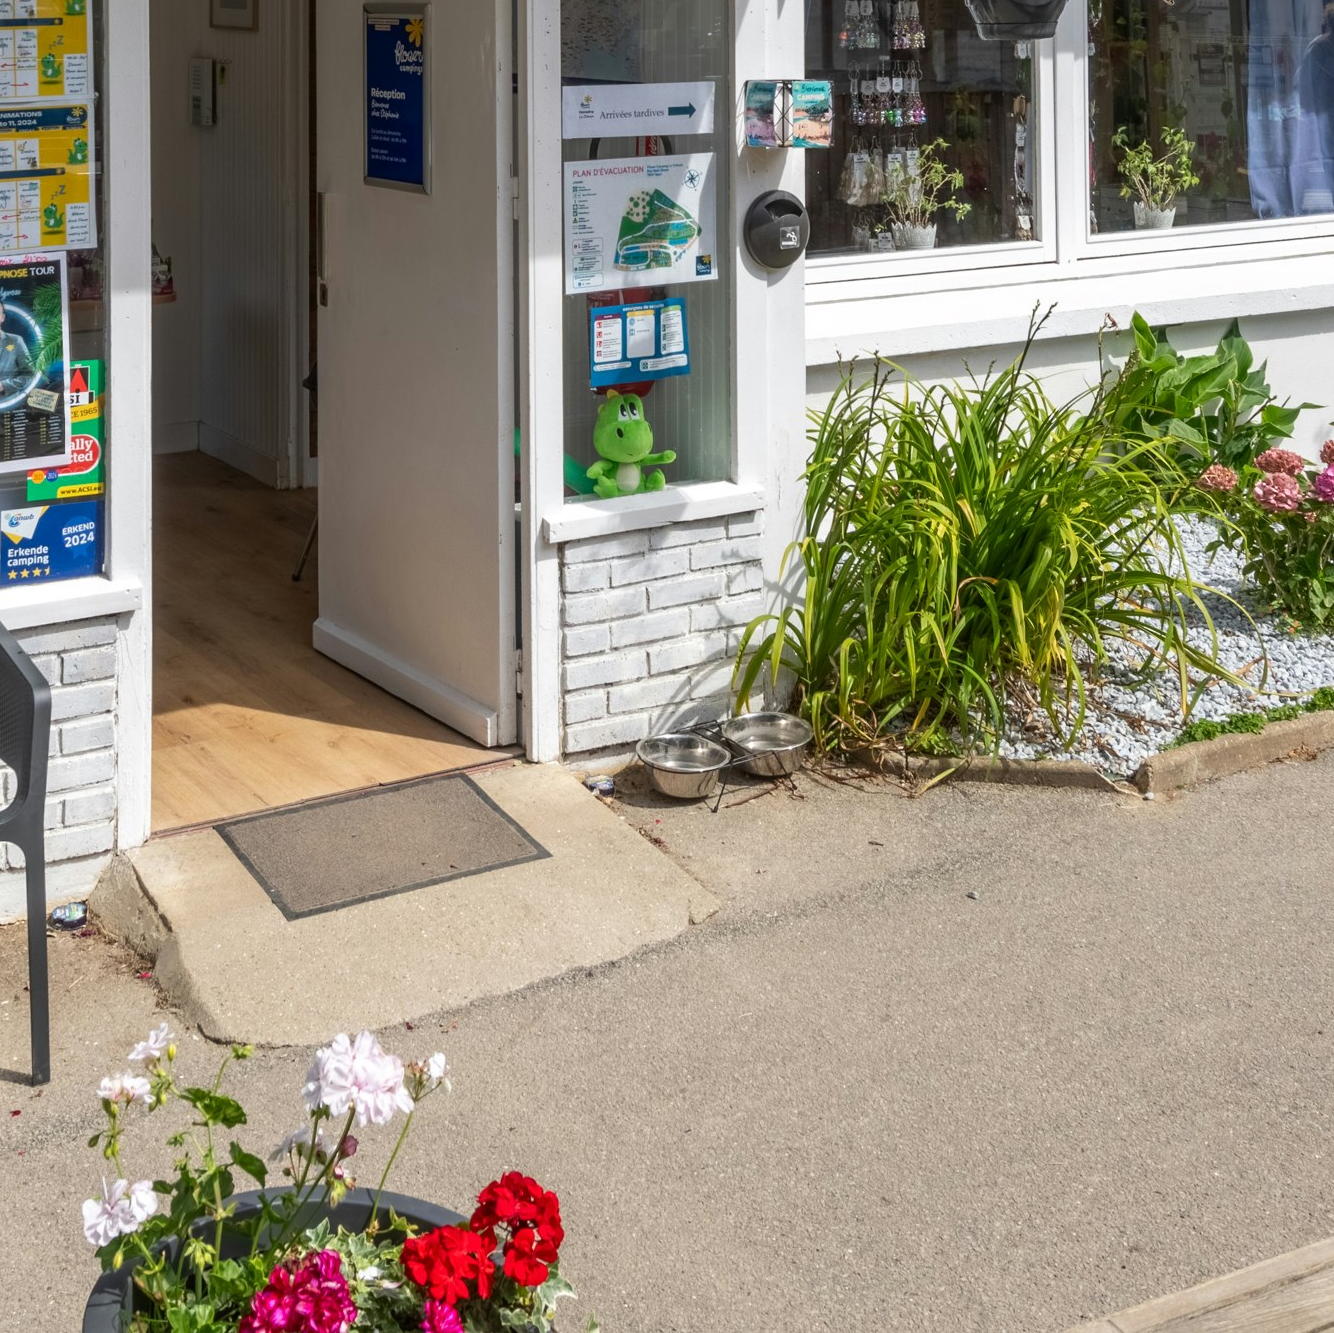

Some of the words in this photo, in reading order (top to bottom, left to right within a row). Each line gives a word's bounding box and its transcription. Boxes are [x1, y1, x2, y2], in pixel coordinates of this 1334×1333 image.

[371, 87, 405, 100] Réception
[600, 111, 632, 120] Arrivées
[634, 109, 664, 117] tardives
[572, 168, 592, 178] PLAN
[593, 165, 644, 177] D'ÉVACUATION
[30, 266, 55, 275] TOUR
[79, 407, 98, 416] 1965
[62, 522, 95, 535] ERKEND
[64, 532, 95, 548] 2024
[8, 545, 49, 557] Erkende
[7, 555, 49, 567] camping
